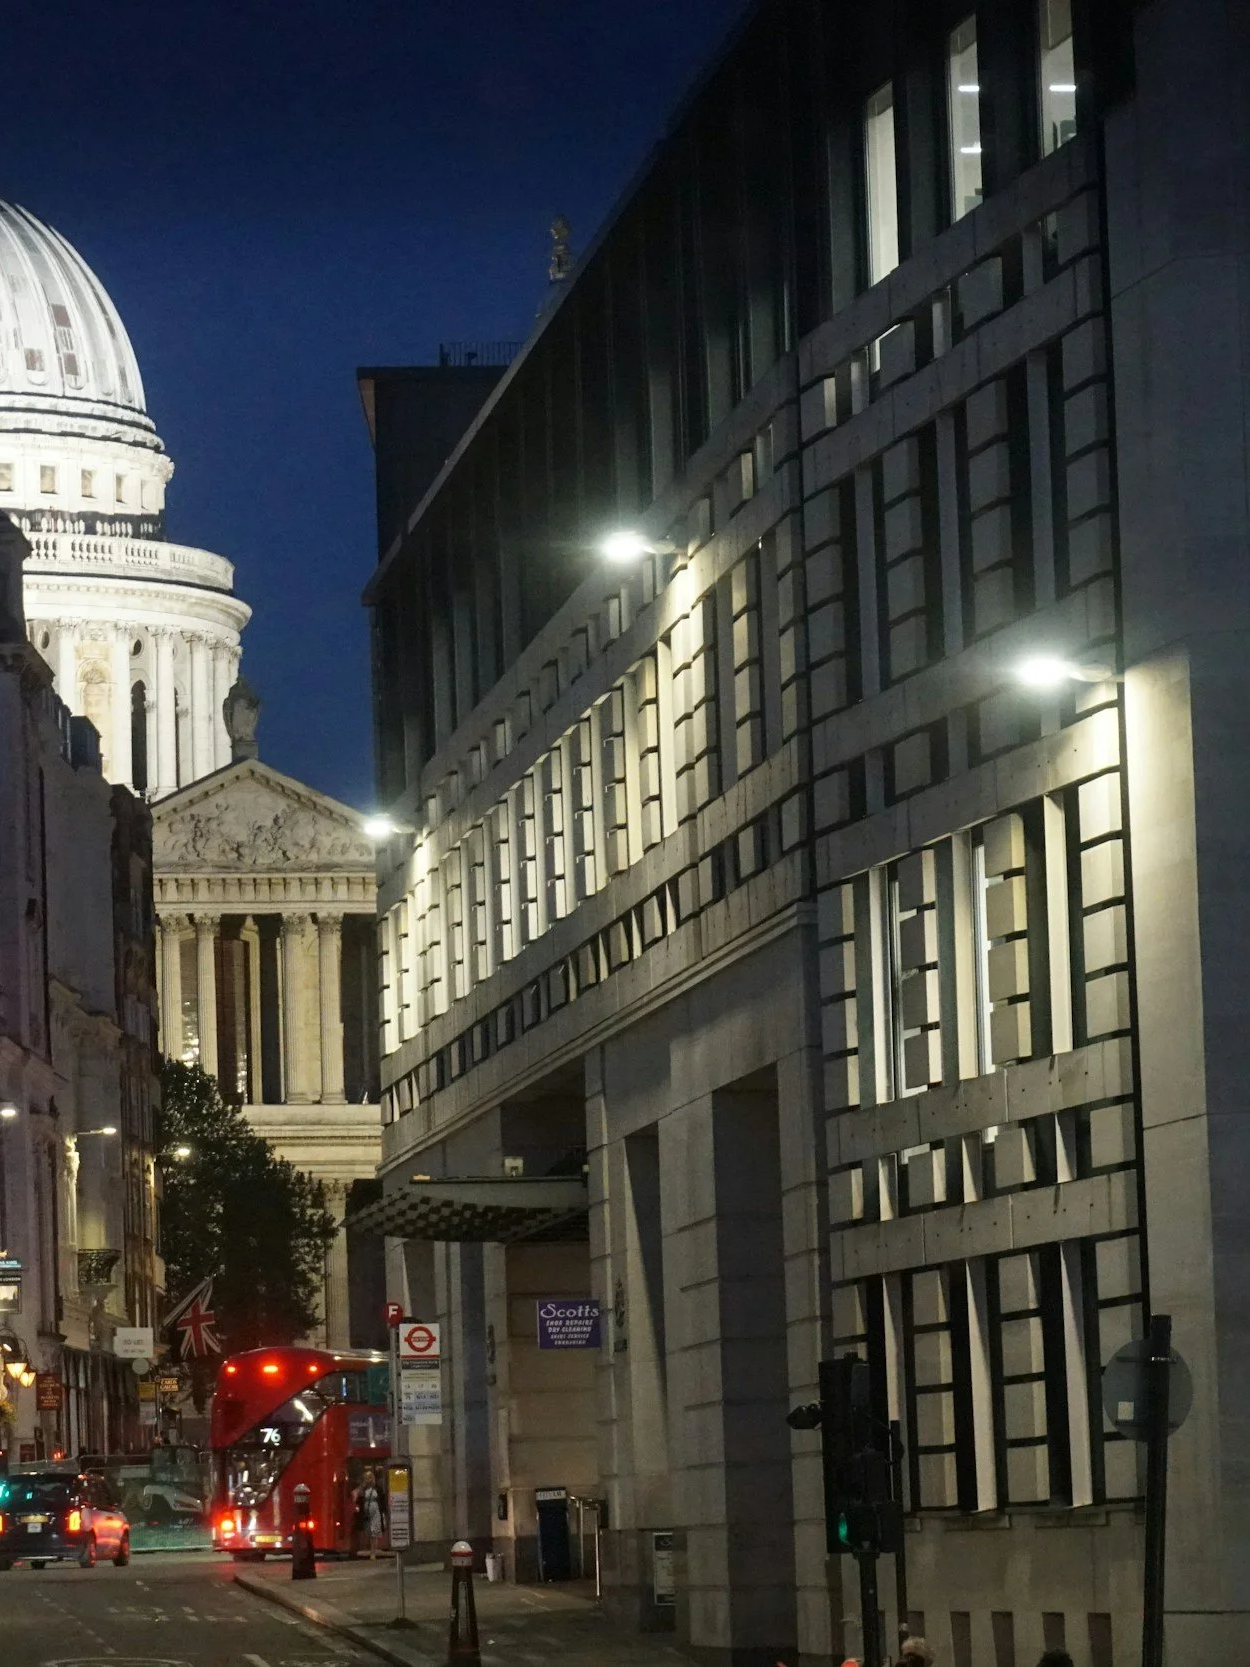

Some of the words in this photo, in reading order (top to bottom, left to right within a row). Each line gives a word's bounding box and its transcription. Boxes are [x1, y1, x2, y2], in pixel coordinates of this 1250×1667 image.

[388, 1305, 399, 1318] F
[540, 1303, 600, 1318] Scotts
[260, 1427, 281, 1443] 76
